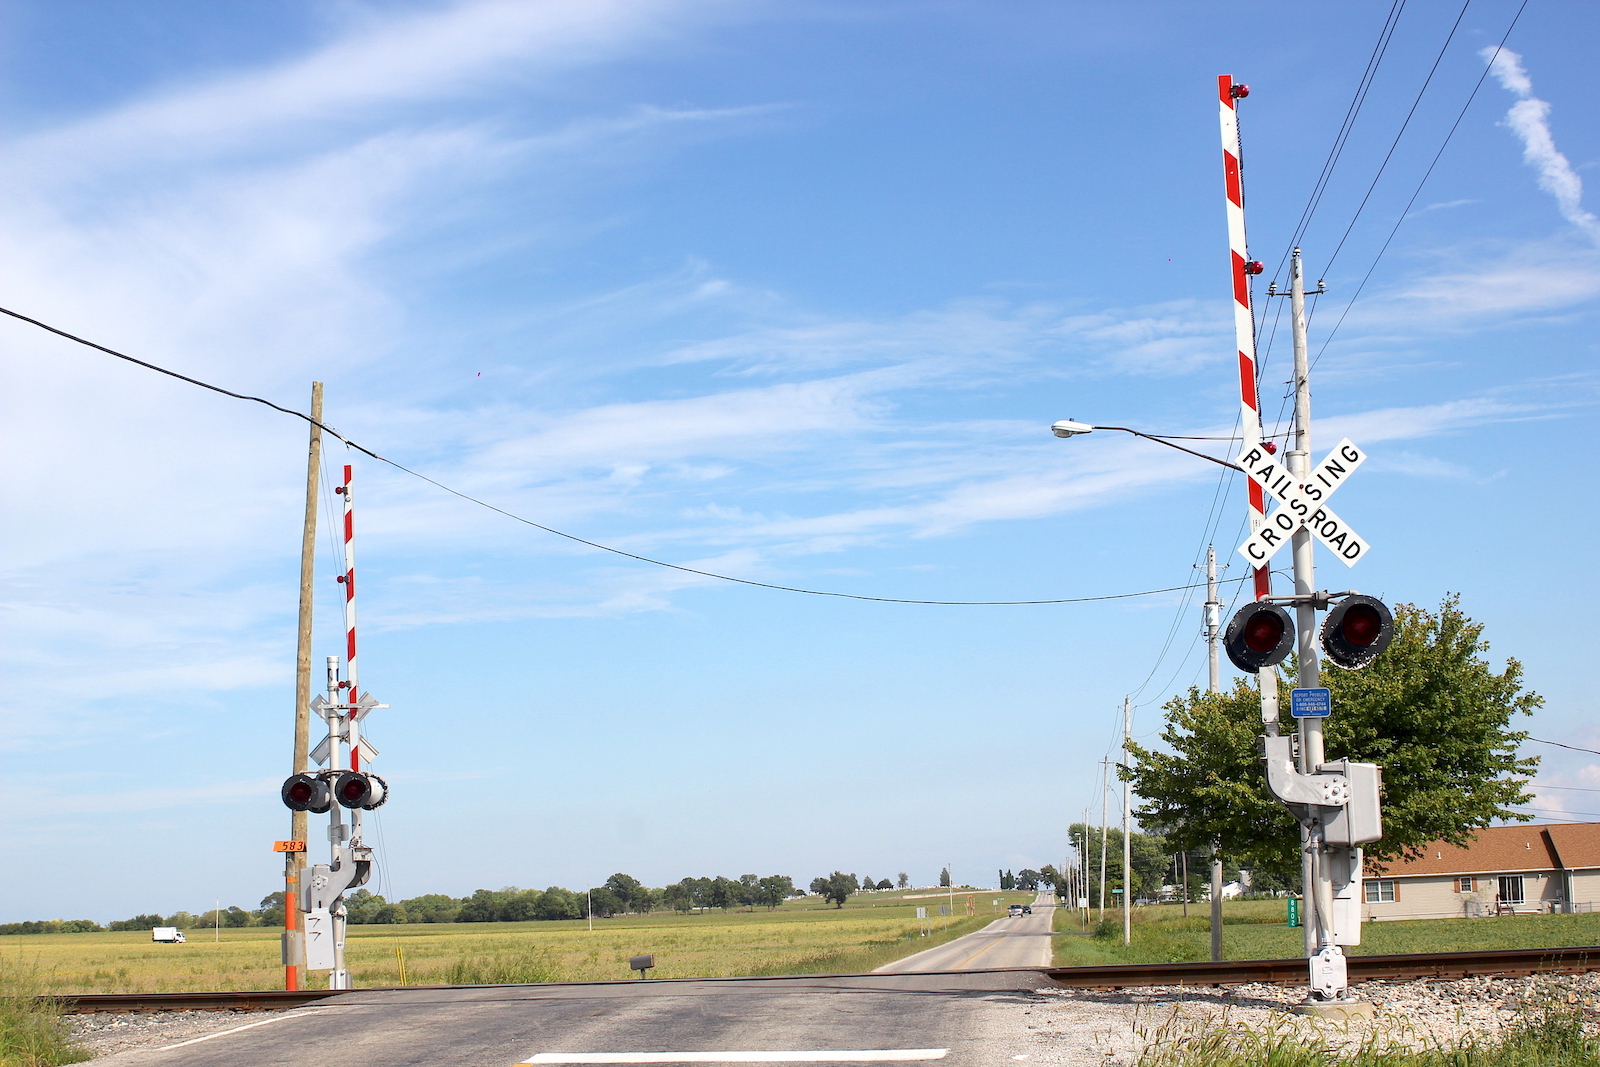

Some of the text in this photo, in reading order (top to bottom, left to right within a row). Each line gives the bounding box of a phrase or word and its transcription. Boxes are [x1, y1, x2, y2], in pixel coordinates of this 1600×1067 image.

[1242, 448, 1361, 559] RAIL ROAD
[1247, 445, 1359, 560] CROSSING
[282, 841, 304, 851] 583
